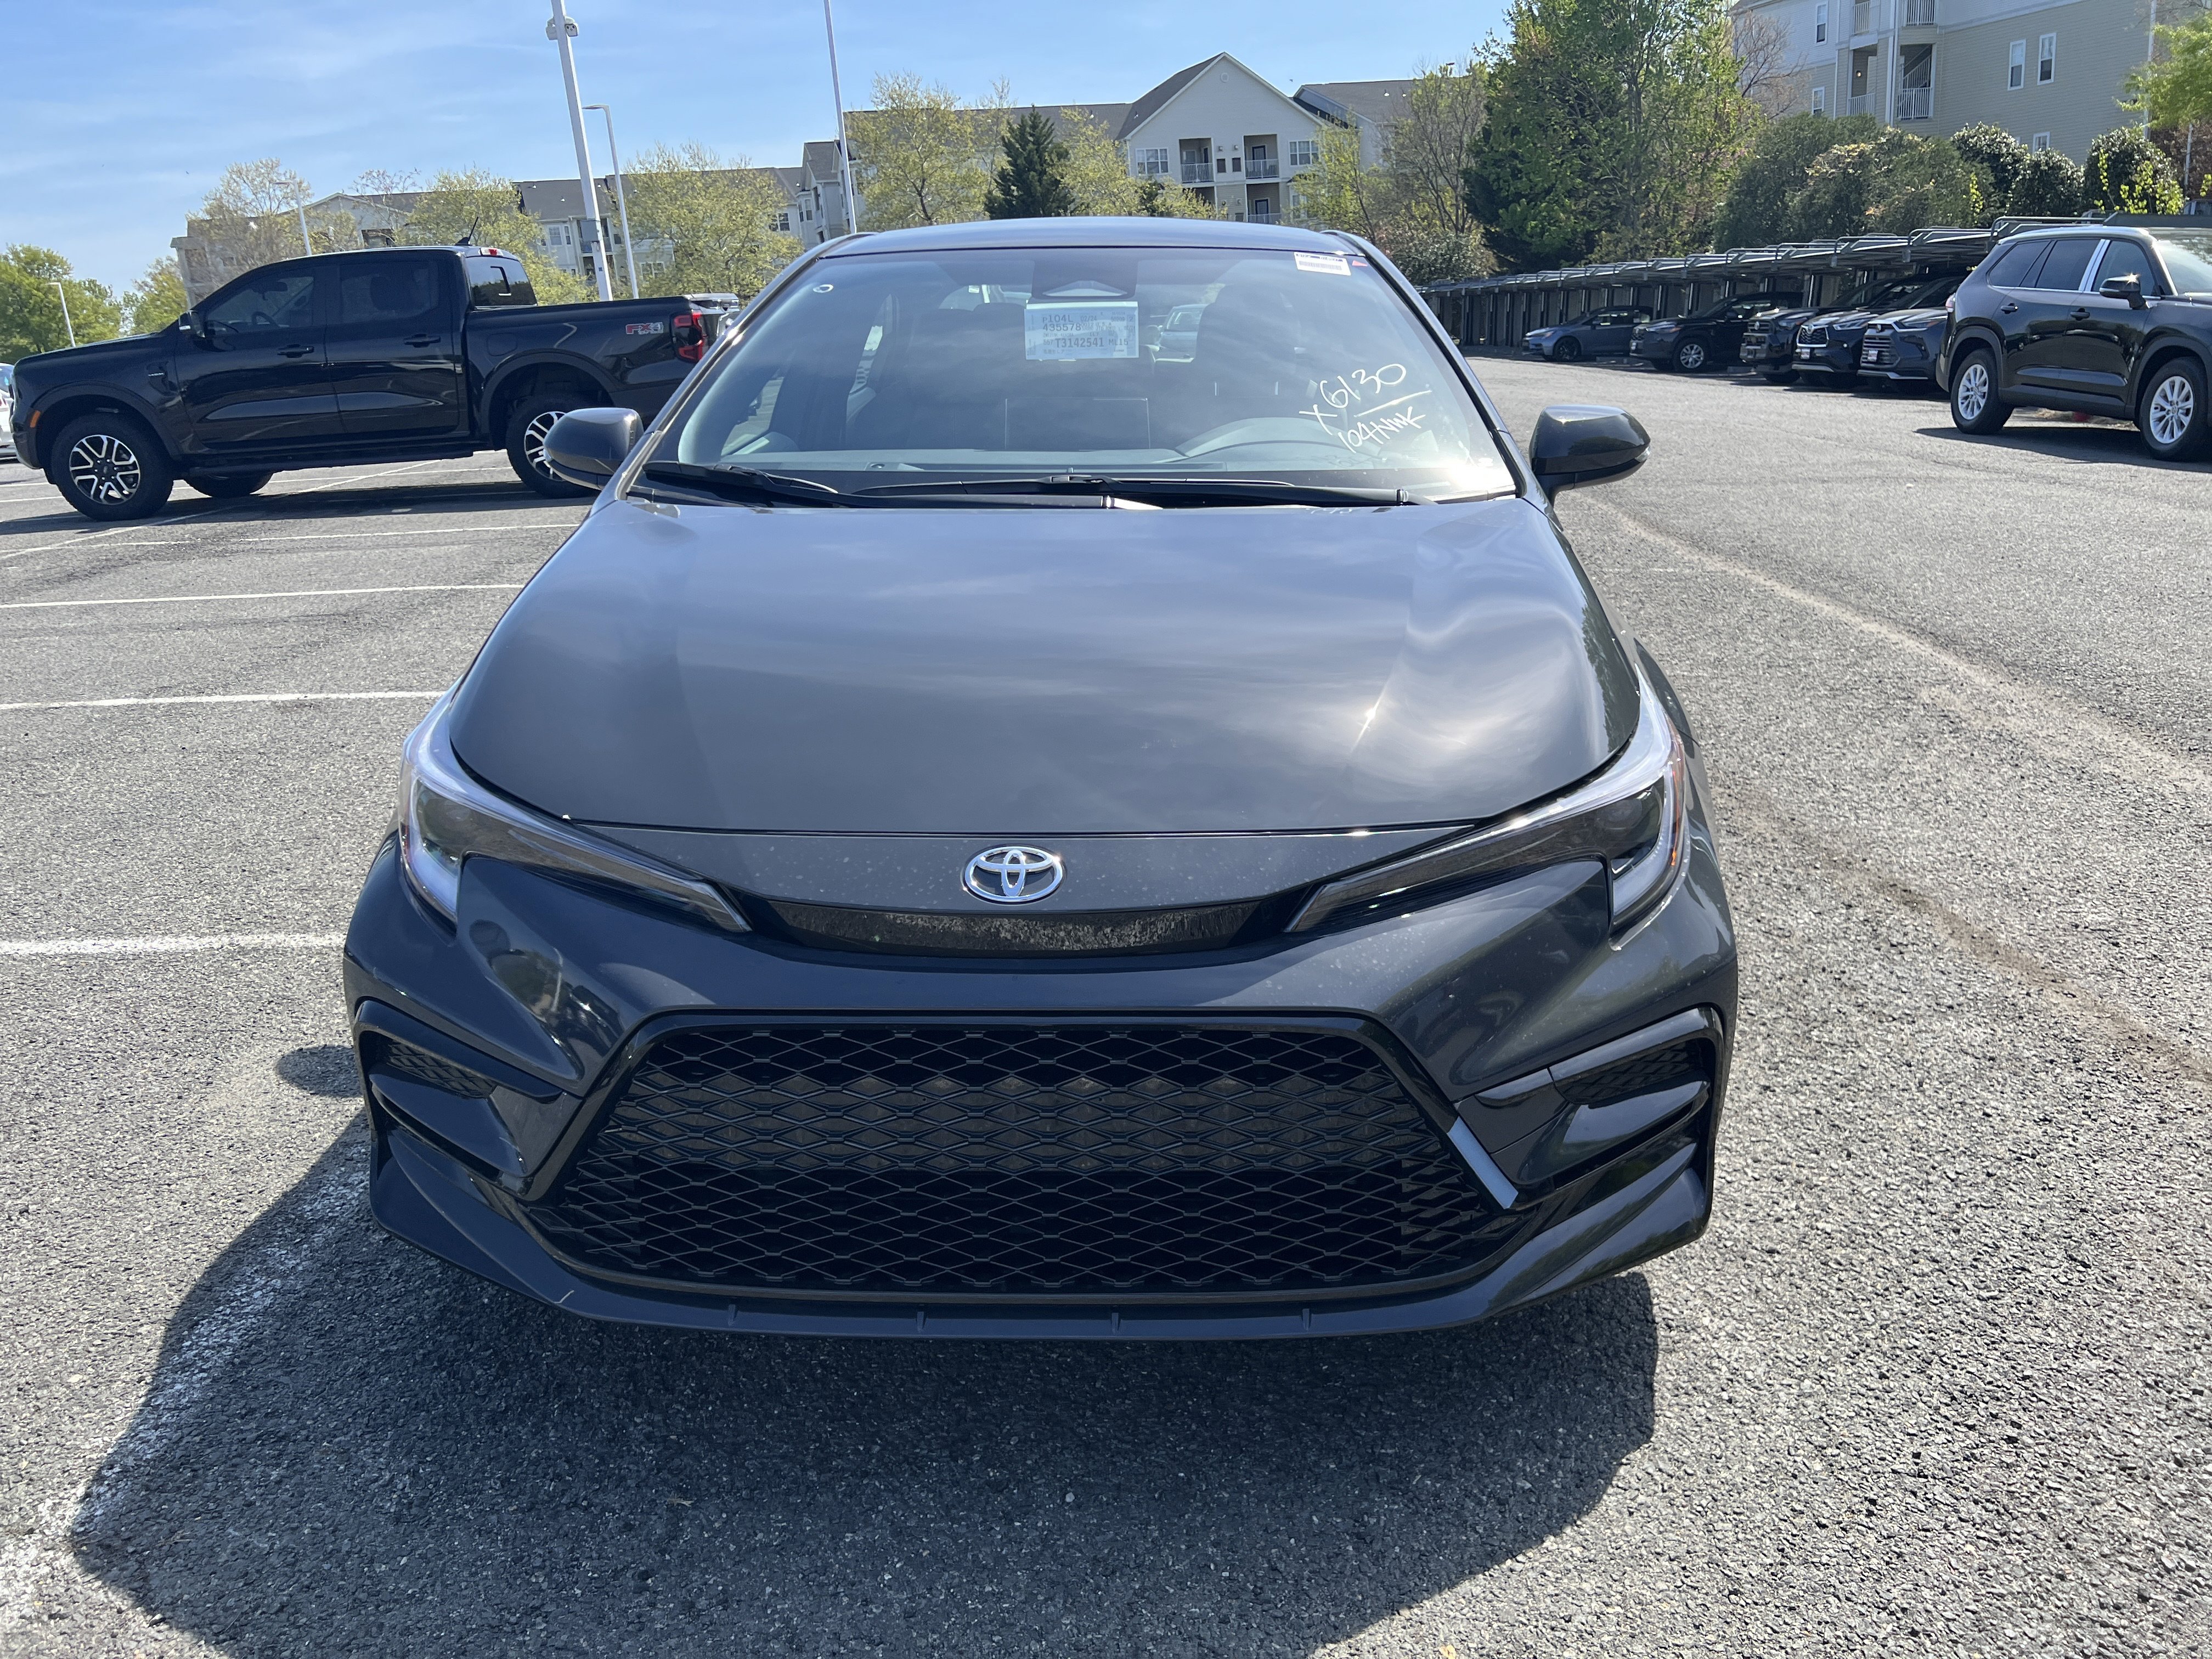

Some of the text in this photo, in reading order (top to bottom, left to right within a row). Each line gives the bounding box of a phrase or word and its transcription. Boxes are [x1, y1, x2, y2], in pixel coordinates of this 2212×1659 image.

[626, 322, 663, 334] FX4
[1043, 323, 1081, 331] 435578
[1056, 337, 1104, 347] T3142541
